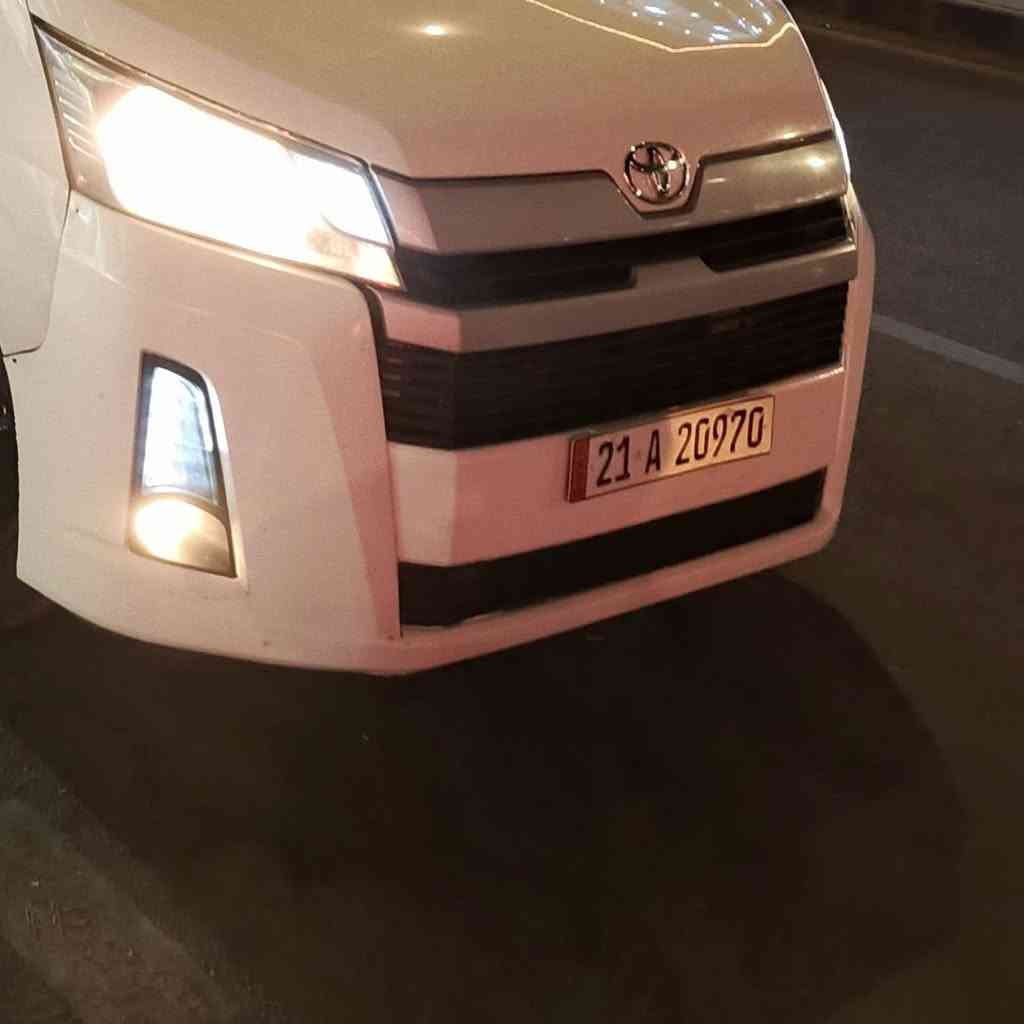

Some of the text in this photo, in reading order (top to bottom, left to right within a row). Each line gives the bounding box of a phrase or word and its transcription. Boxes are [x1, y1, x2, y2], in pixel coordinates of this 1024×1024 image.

[596, 406, 764, 487] 21 A 20970
